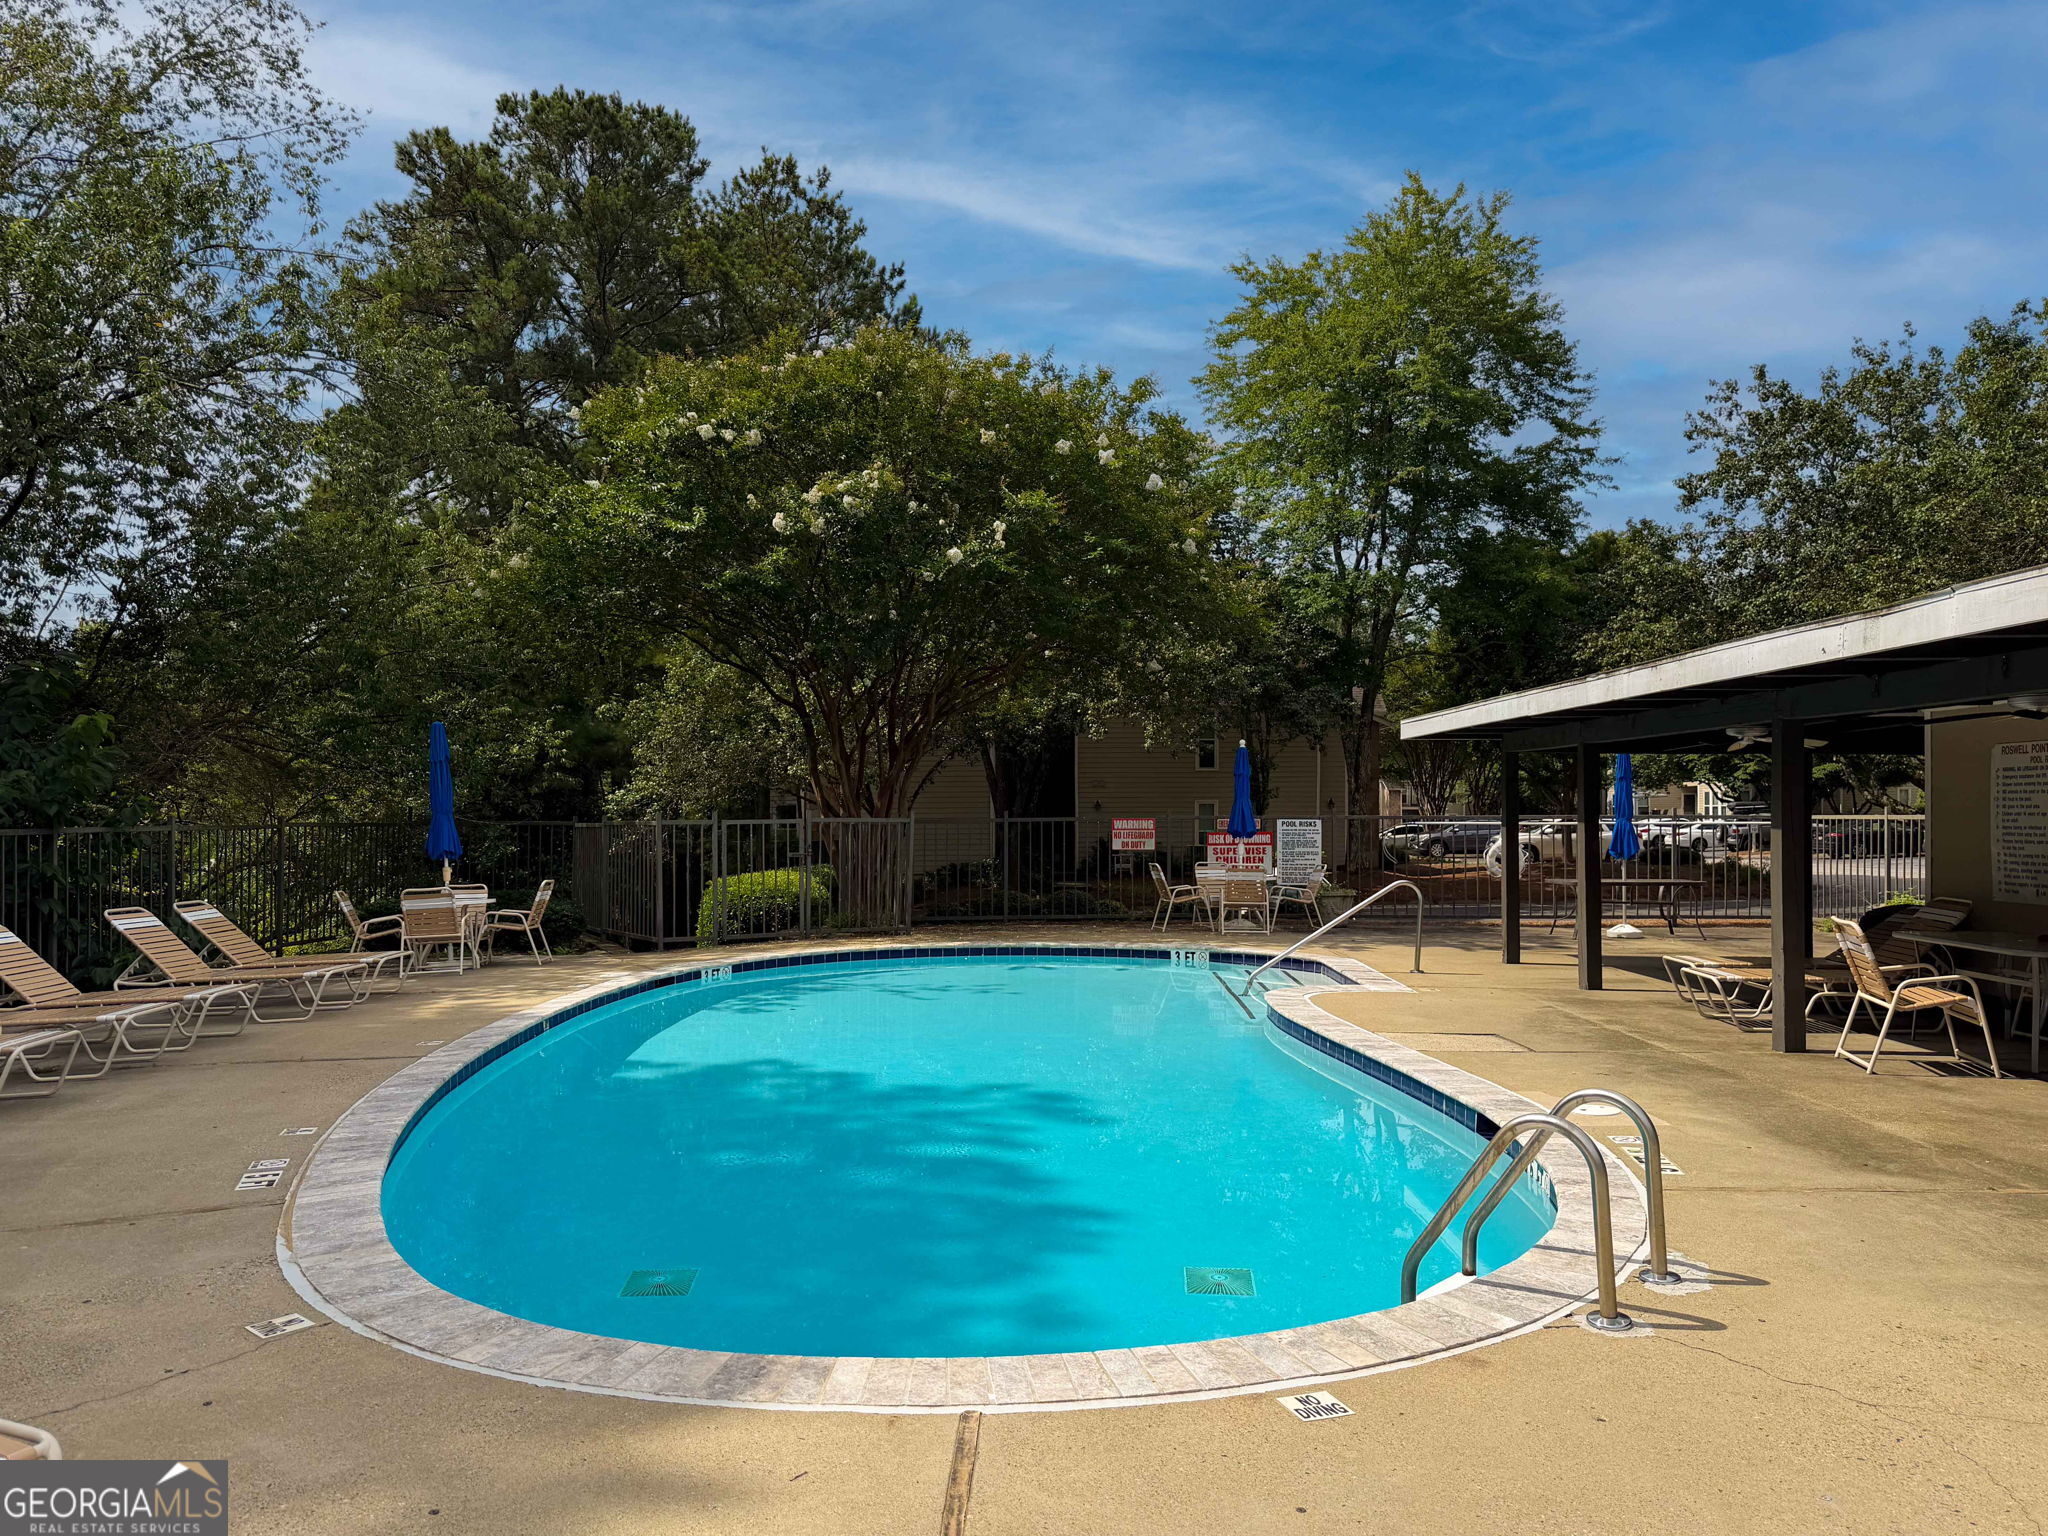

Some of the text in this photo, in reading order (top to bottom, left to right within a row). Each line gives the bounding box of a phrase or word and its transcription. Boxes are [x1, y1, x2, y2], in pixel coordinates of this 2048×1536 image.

[2001, 745, 2029, 755] ROSWELL
[1114, 820, 1154, 829] WARNING
[1113, 831, 1154, 839] NO LIFEGUARD
[1209, 834, 1225, 844] RISK
[1225, 834, 1233, 844] OF
[1234, 834, 1271, 844] DOWNING
[1212, 847, 1267, 855] SUPEVISE
[1215, 856, 1264, 864] CHILREN
[1294, 1395, 1321, 1407] NO
[1293, 1402, 1349, 1419] DIVING
